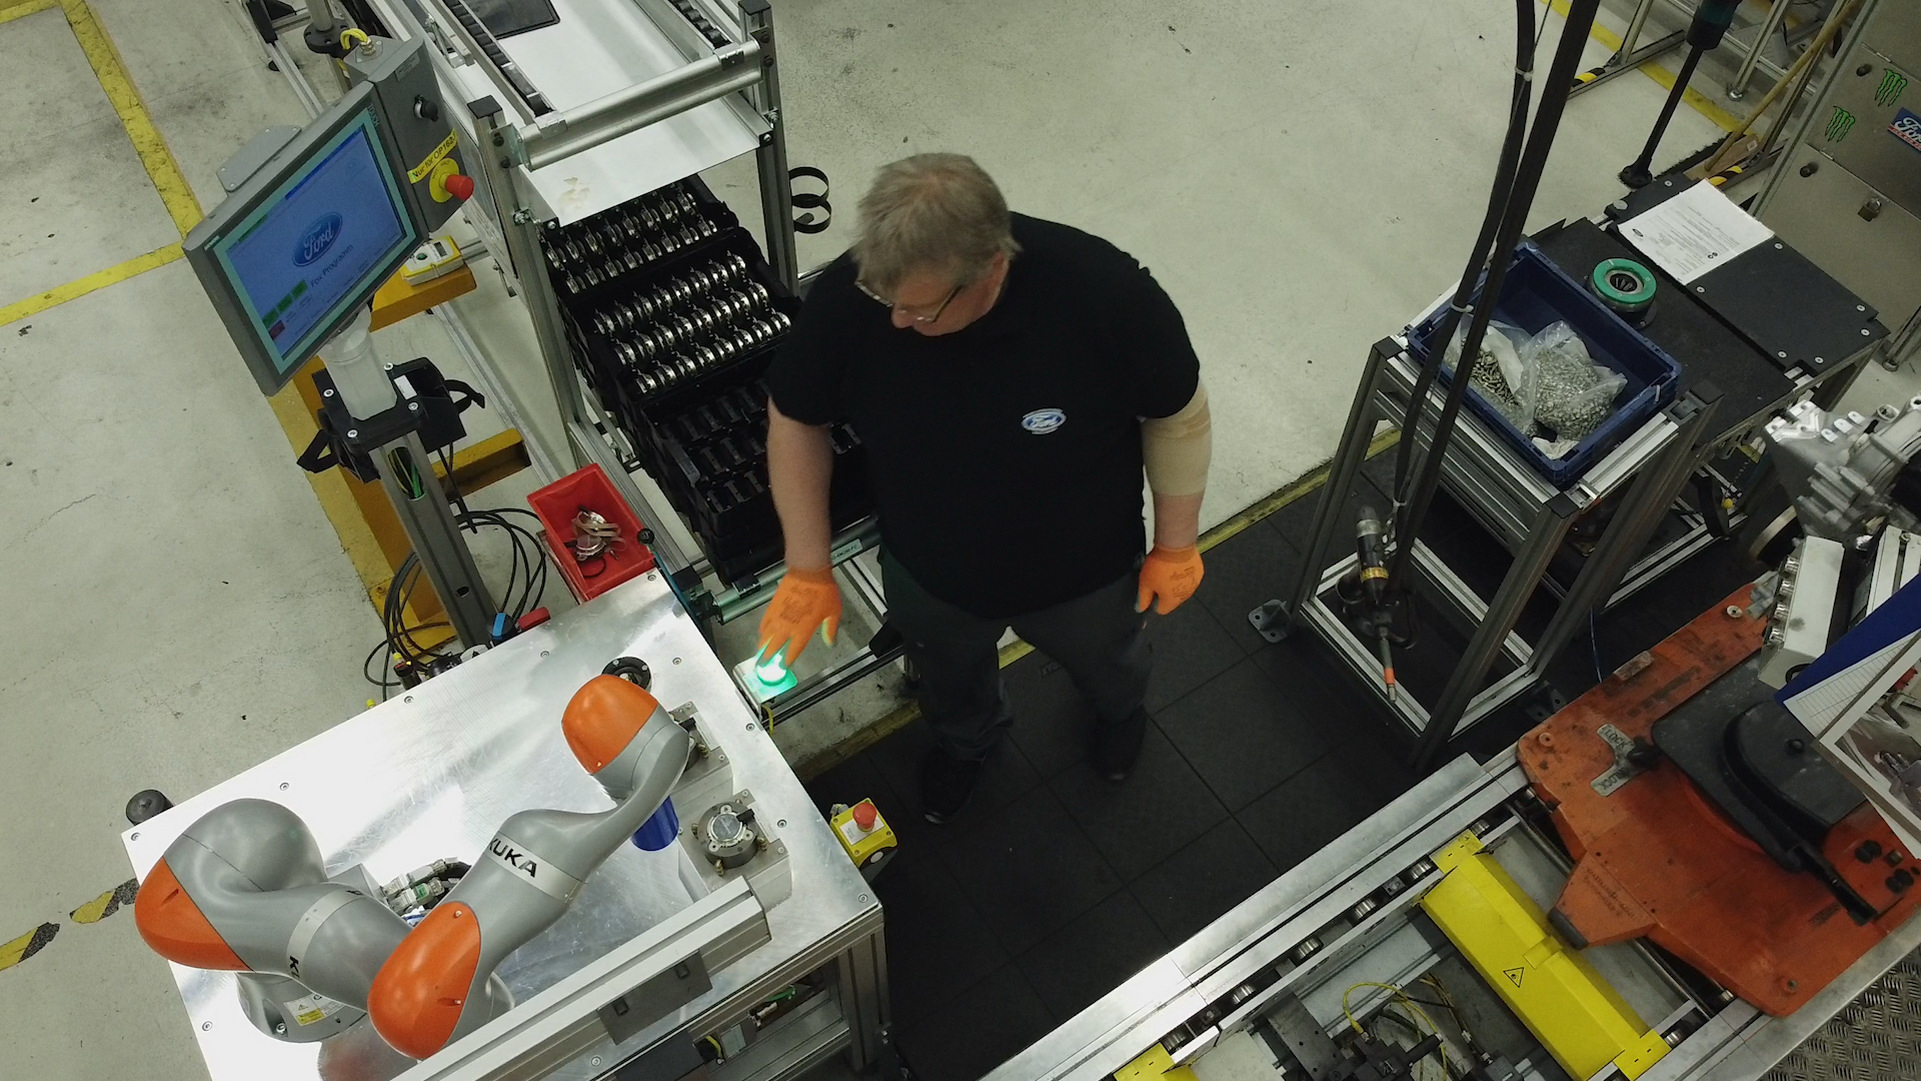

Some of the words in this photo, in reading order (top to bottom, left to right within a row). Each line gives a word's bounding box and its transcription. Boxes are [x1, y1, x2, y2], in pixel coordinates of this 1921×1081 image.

[412, 166, 425, 177] Nur
[425, 156, 434, 168] für
[303, 221, 334, 260] Ford
[310, 275, 322, 288] Fox
[322, 244, 354, 276] Programm
[1604, 728, 1629, 750] LOCK
